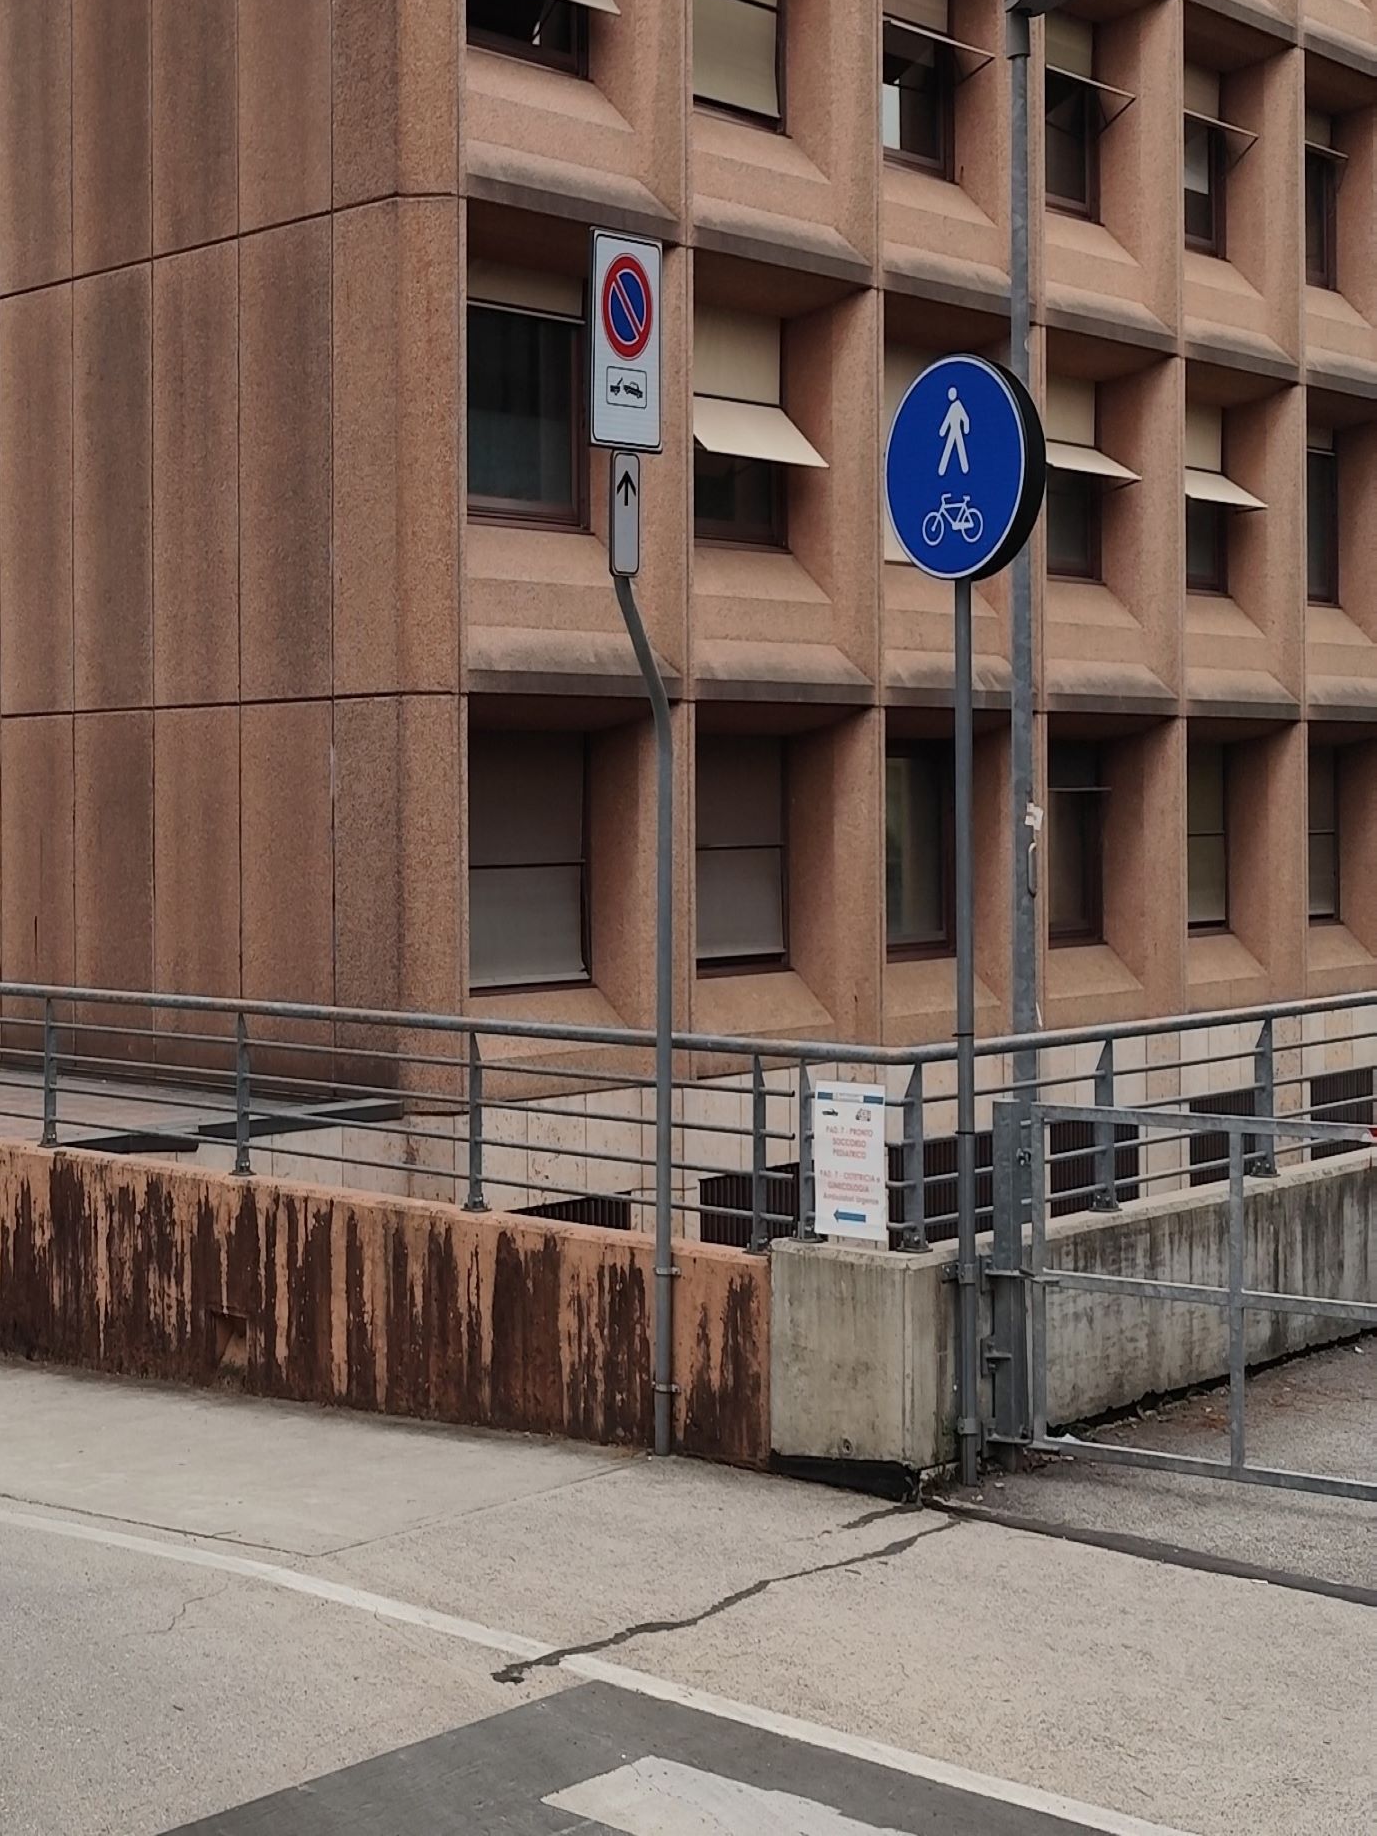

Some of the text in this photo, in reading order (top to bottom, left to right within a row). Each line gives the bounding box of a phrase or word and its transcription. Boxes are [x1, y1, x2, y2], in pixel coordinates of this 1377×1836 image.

[849, 1128, 873, 1138] PRONTO
[832, 1137, 867, 1148] SOCCORSO
[833, 1148, 867, 1159] PEDIATRICO
[827, 1181, 870, 1192] GINECOLOGIA
